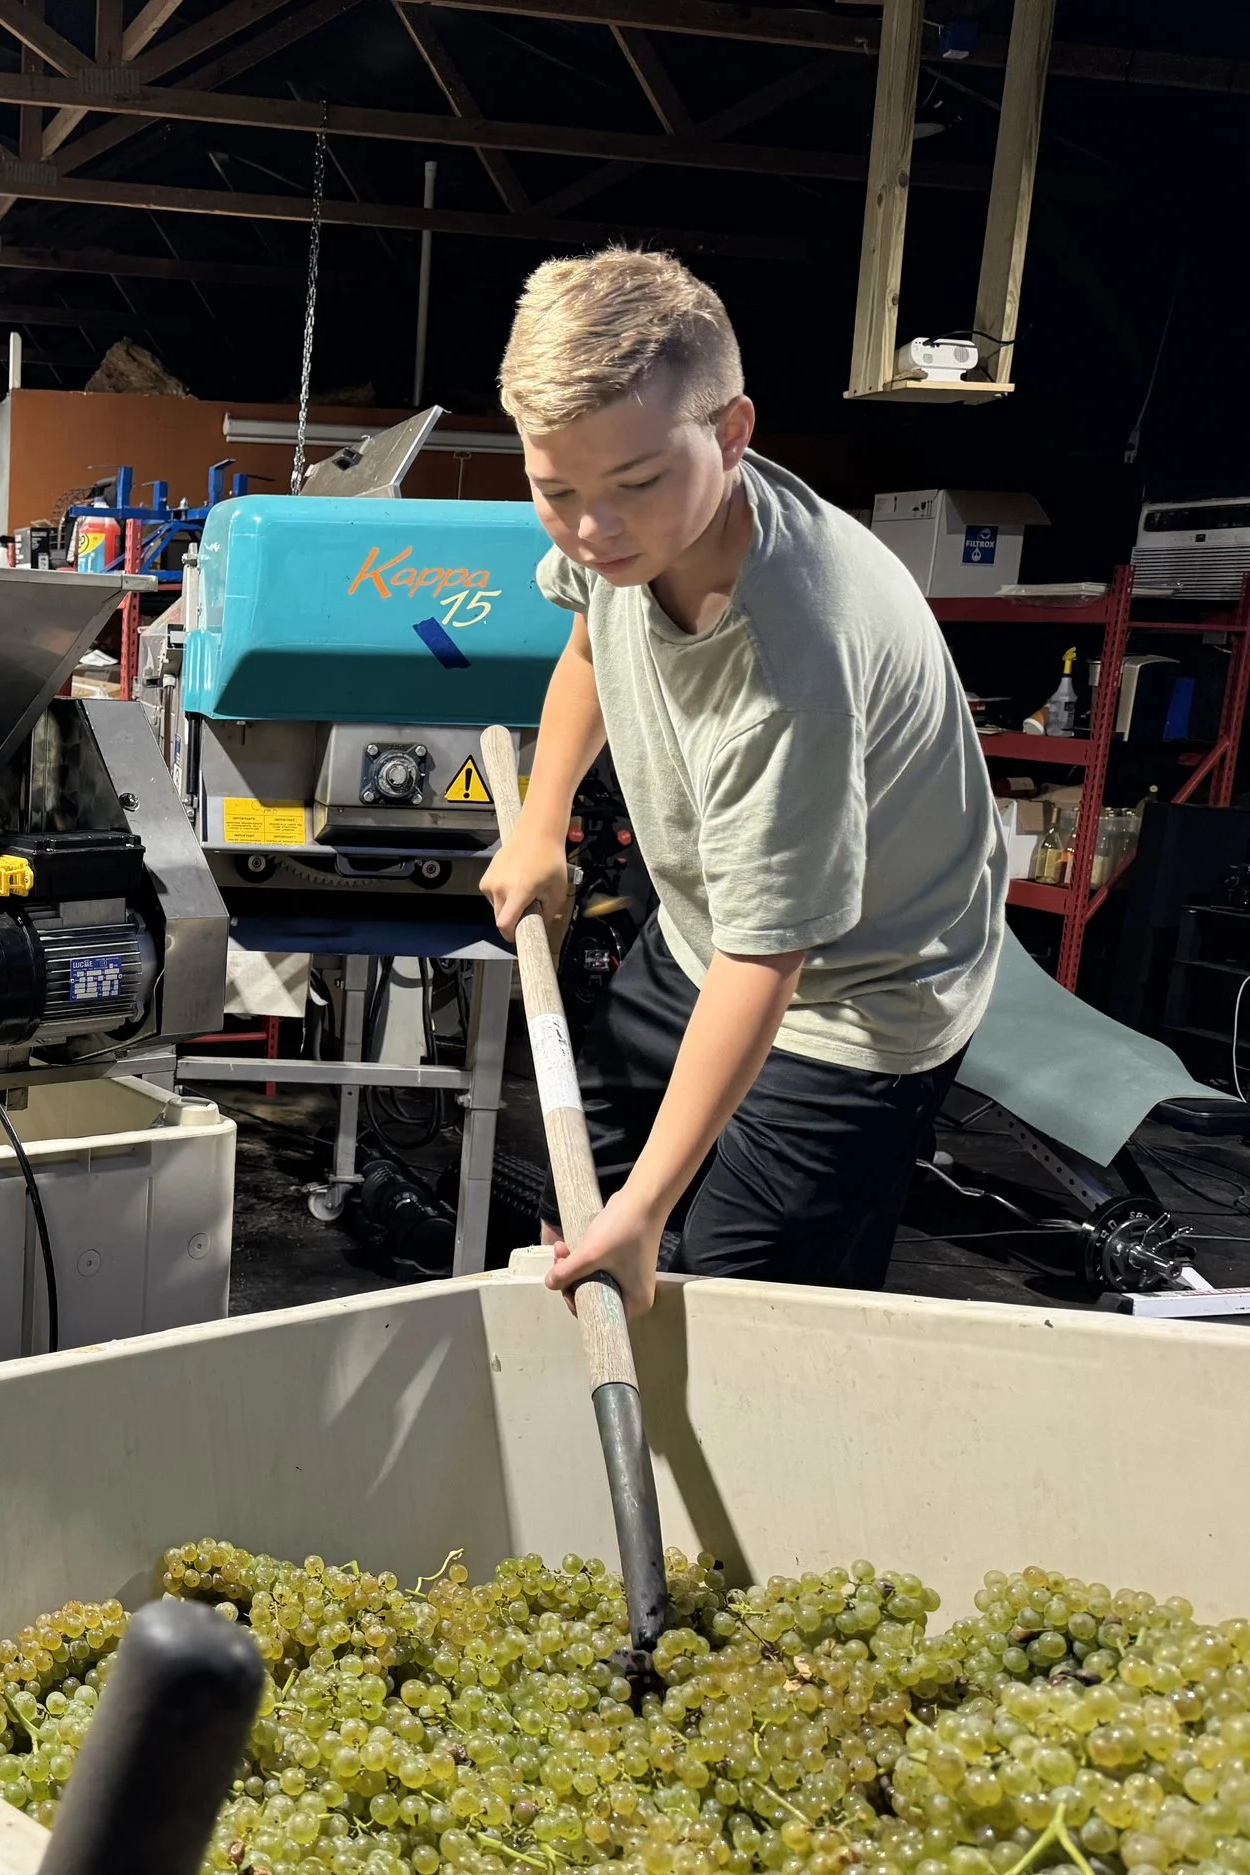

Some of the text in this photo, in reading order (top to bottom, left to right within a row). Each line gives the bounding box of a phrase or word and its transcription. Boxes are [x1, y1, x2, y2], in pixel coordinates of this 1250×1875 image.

[965, 540, 995, 548] FILTROX
[347, 545, 491, 599] Kappa
[439, 590, 503, 628] 15
